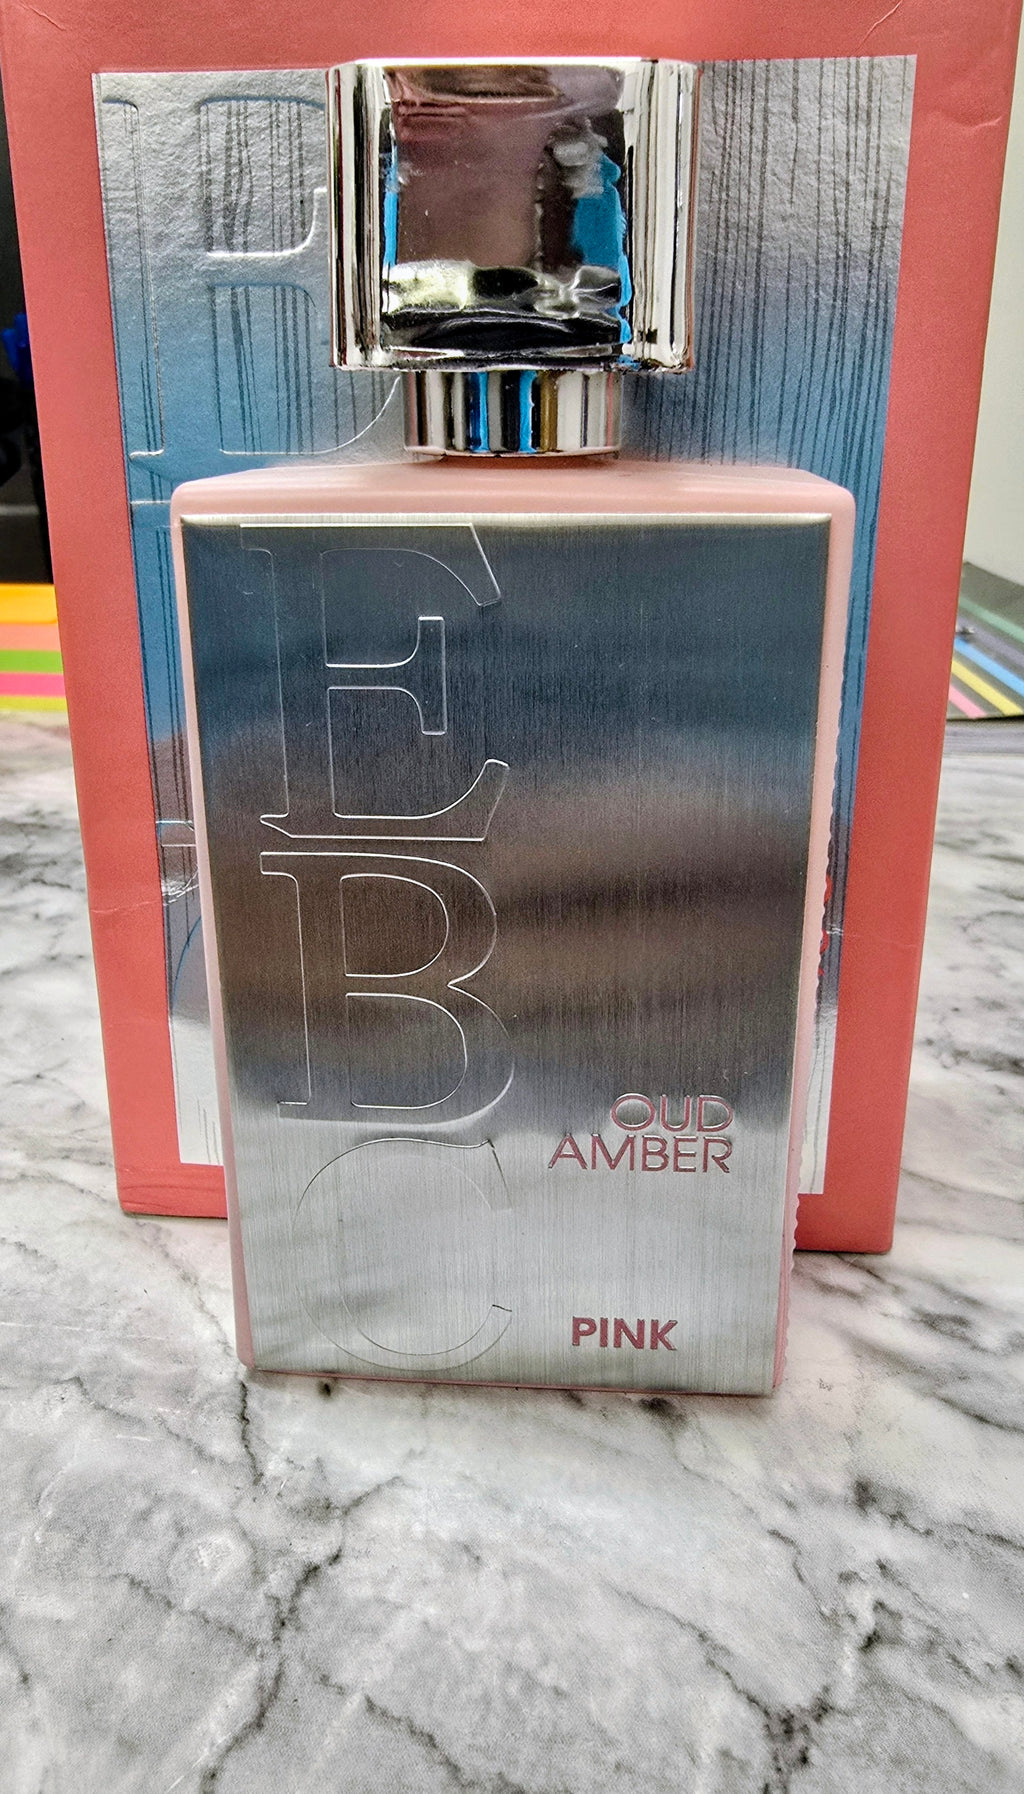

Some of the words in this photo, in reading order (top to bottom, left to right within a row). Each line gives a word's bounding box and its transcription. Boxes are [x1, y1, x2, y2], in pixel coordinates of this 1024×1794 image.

[610, 1092, 734, 1132] OUD
[548, 1132, 734, 1174] AMBER
[571, 1316, 678, 1351] PINK
